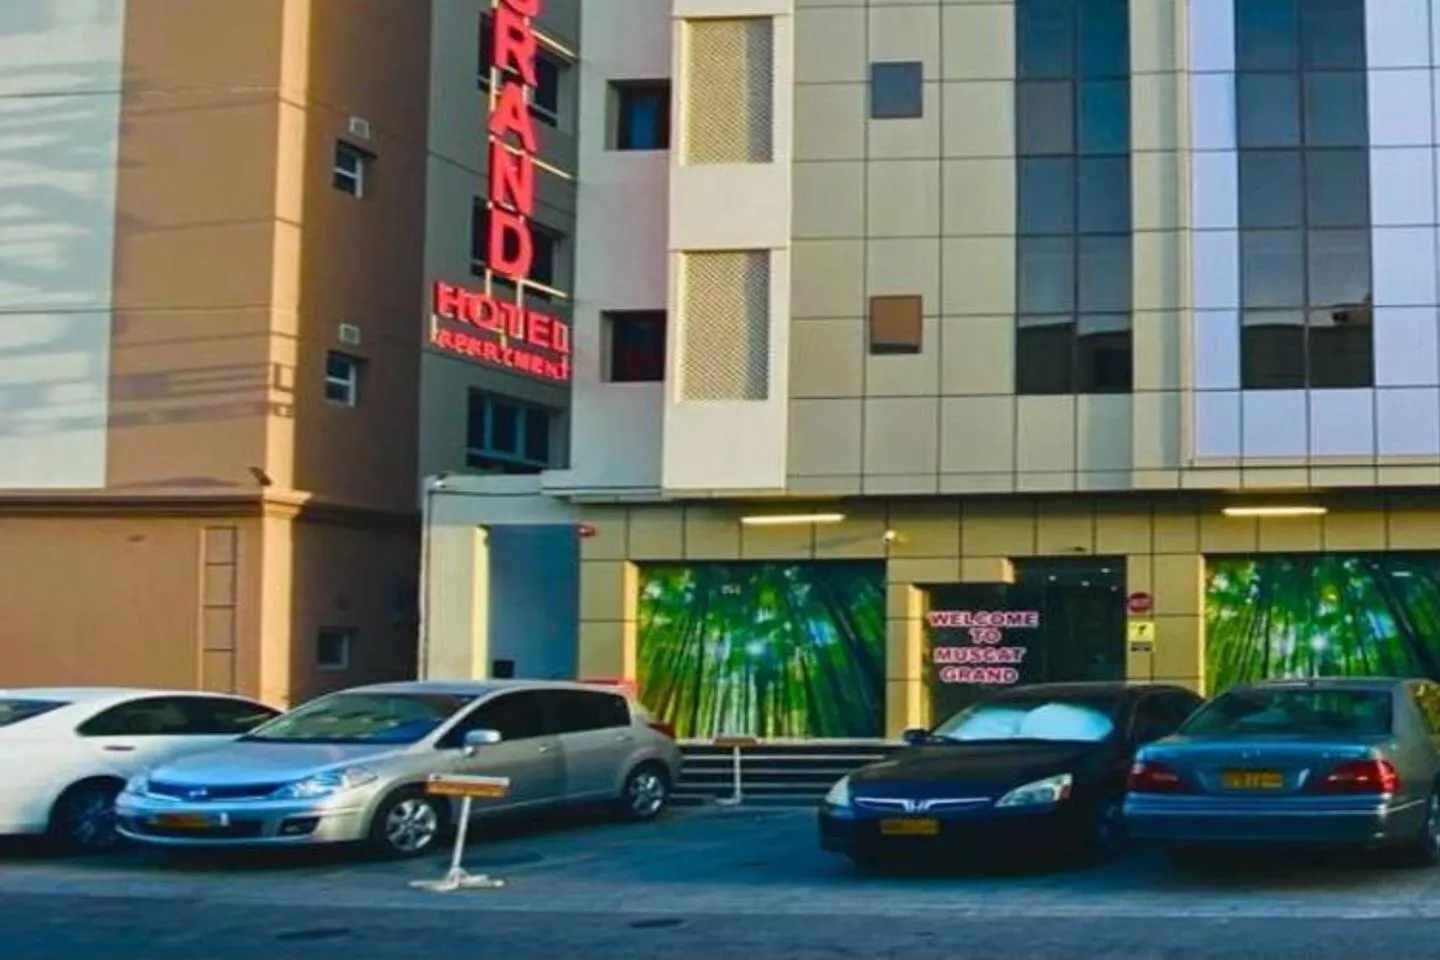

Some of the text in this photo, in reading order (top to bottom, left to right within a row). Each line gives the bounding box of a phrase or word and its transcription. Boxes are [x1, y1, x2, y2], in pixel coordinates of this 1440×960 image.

[434, 281, 570, 354] HOTEL
[927, 611, 1039, 627] WELCOME
[969, 628, 1002, 644] TO
[933, 647, 1026, 663] MUSCAT
[939, 667, 1018, 683] GRAND
